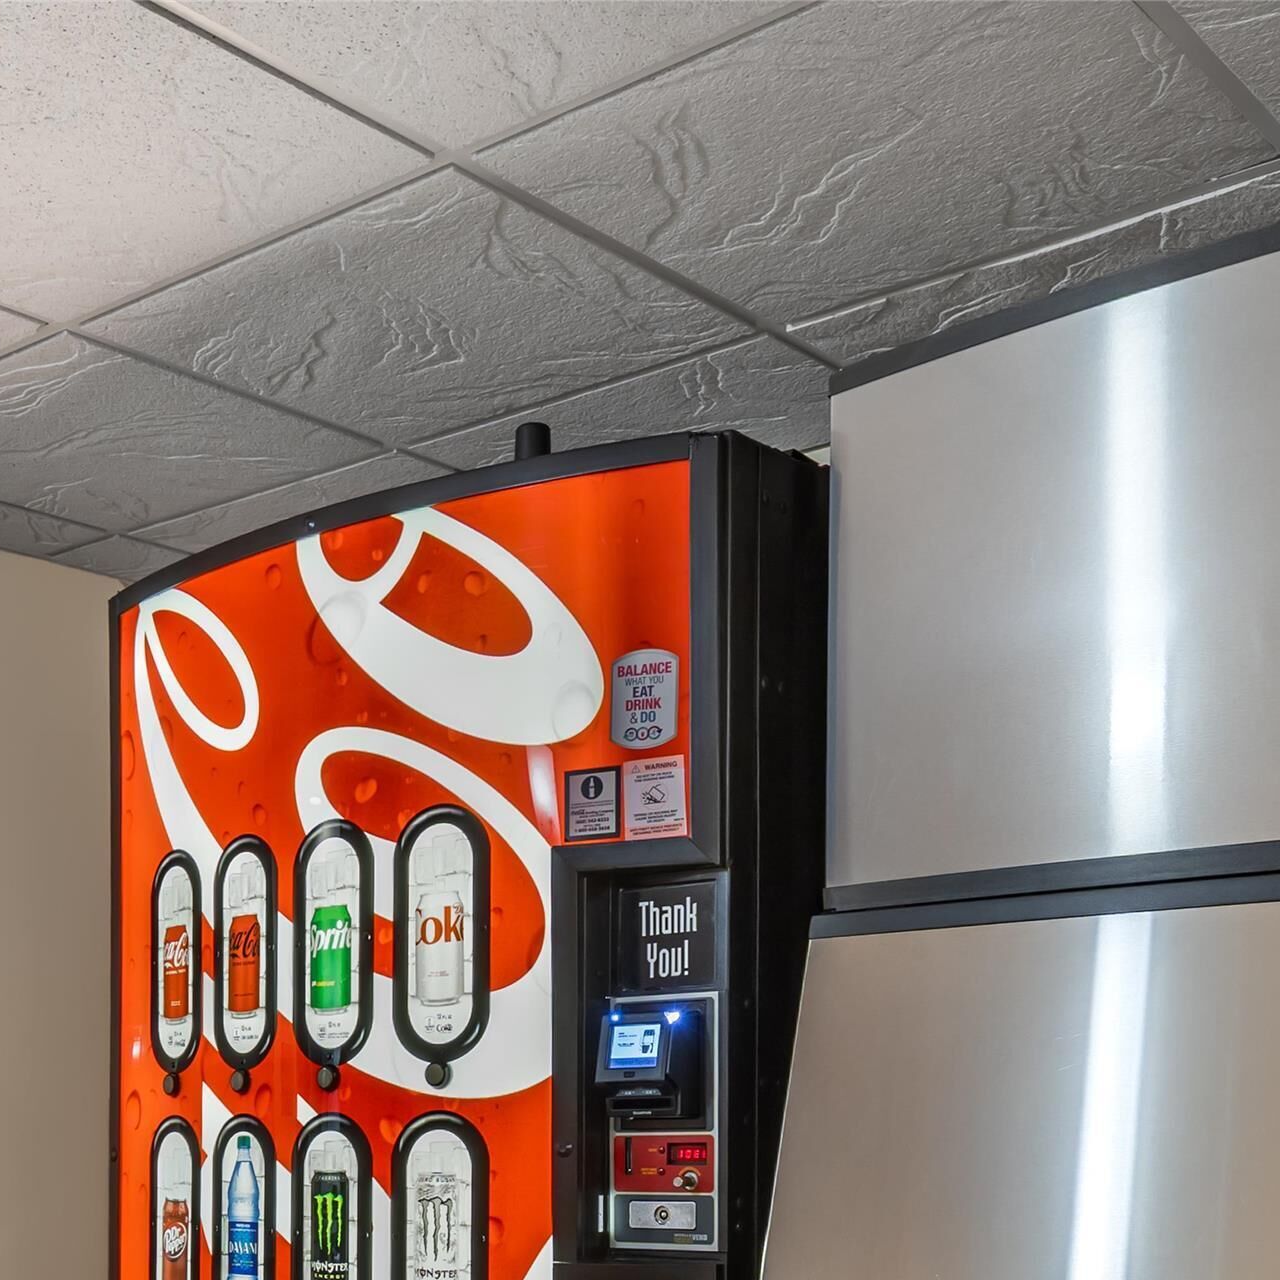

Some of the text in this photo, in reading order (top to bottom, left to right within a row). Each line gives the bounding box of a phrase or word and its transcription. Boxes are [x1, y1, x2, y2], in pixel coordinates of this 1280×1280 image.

[617, 661, 672, 678] BALANCE
[625, 675, 664, 686] WHAT YOU
[625, 697, 662, 711] DRINK
[630, 711, 656, 724] & DO
[644, 761, 678, 770] WARNING
[638, 896, 697, 937] Thank
